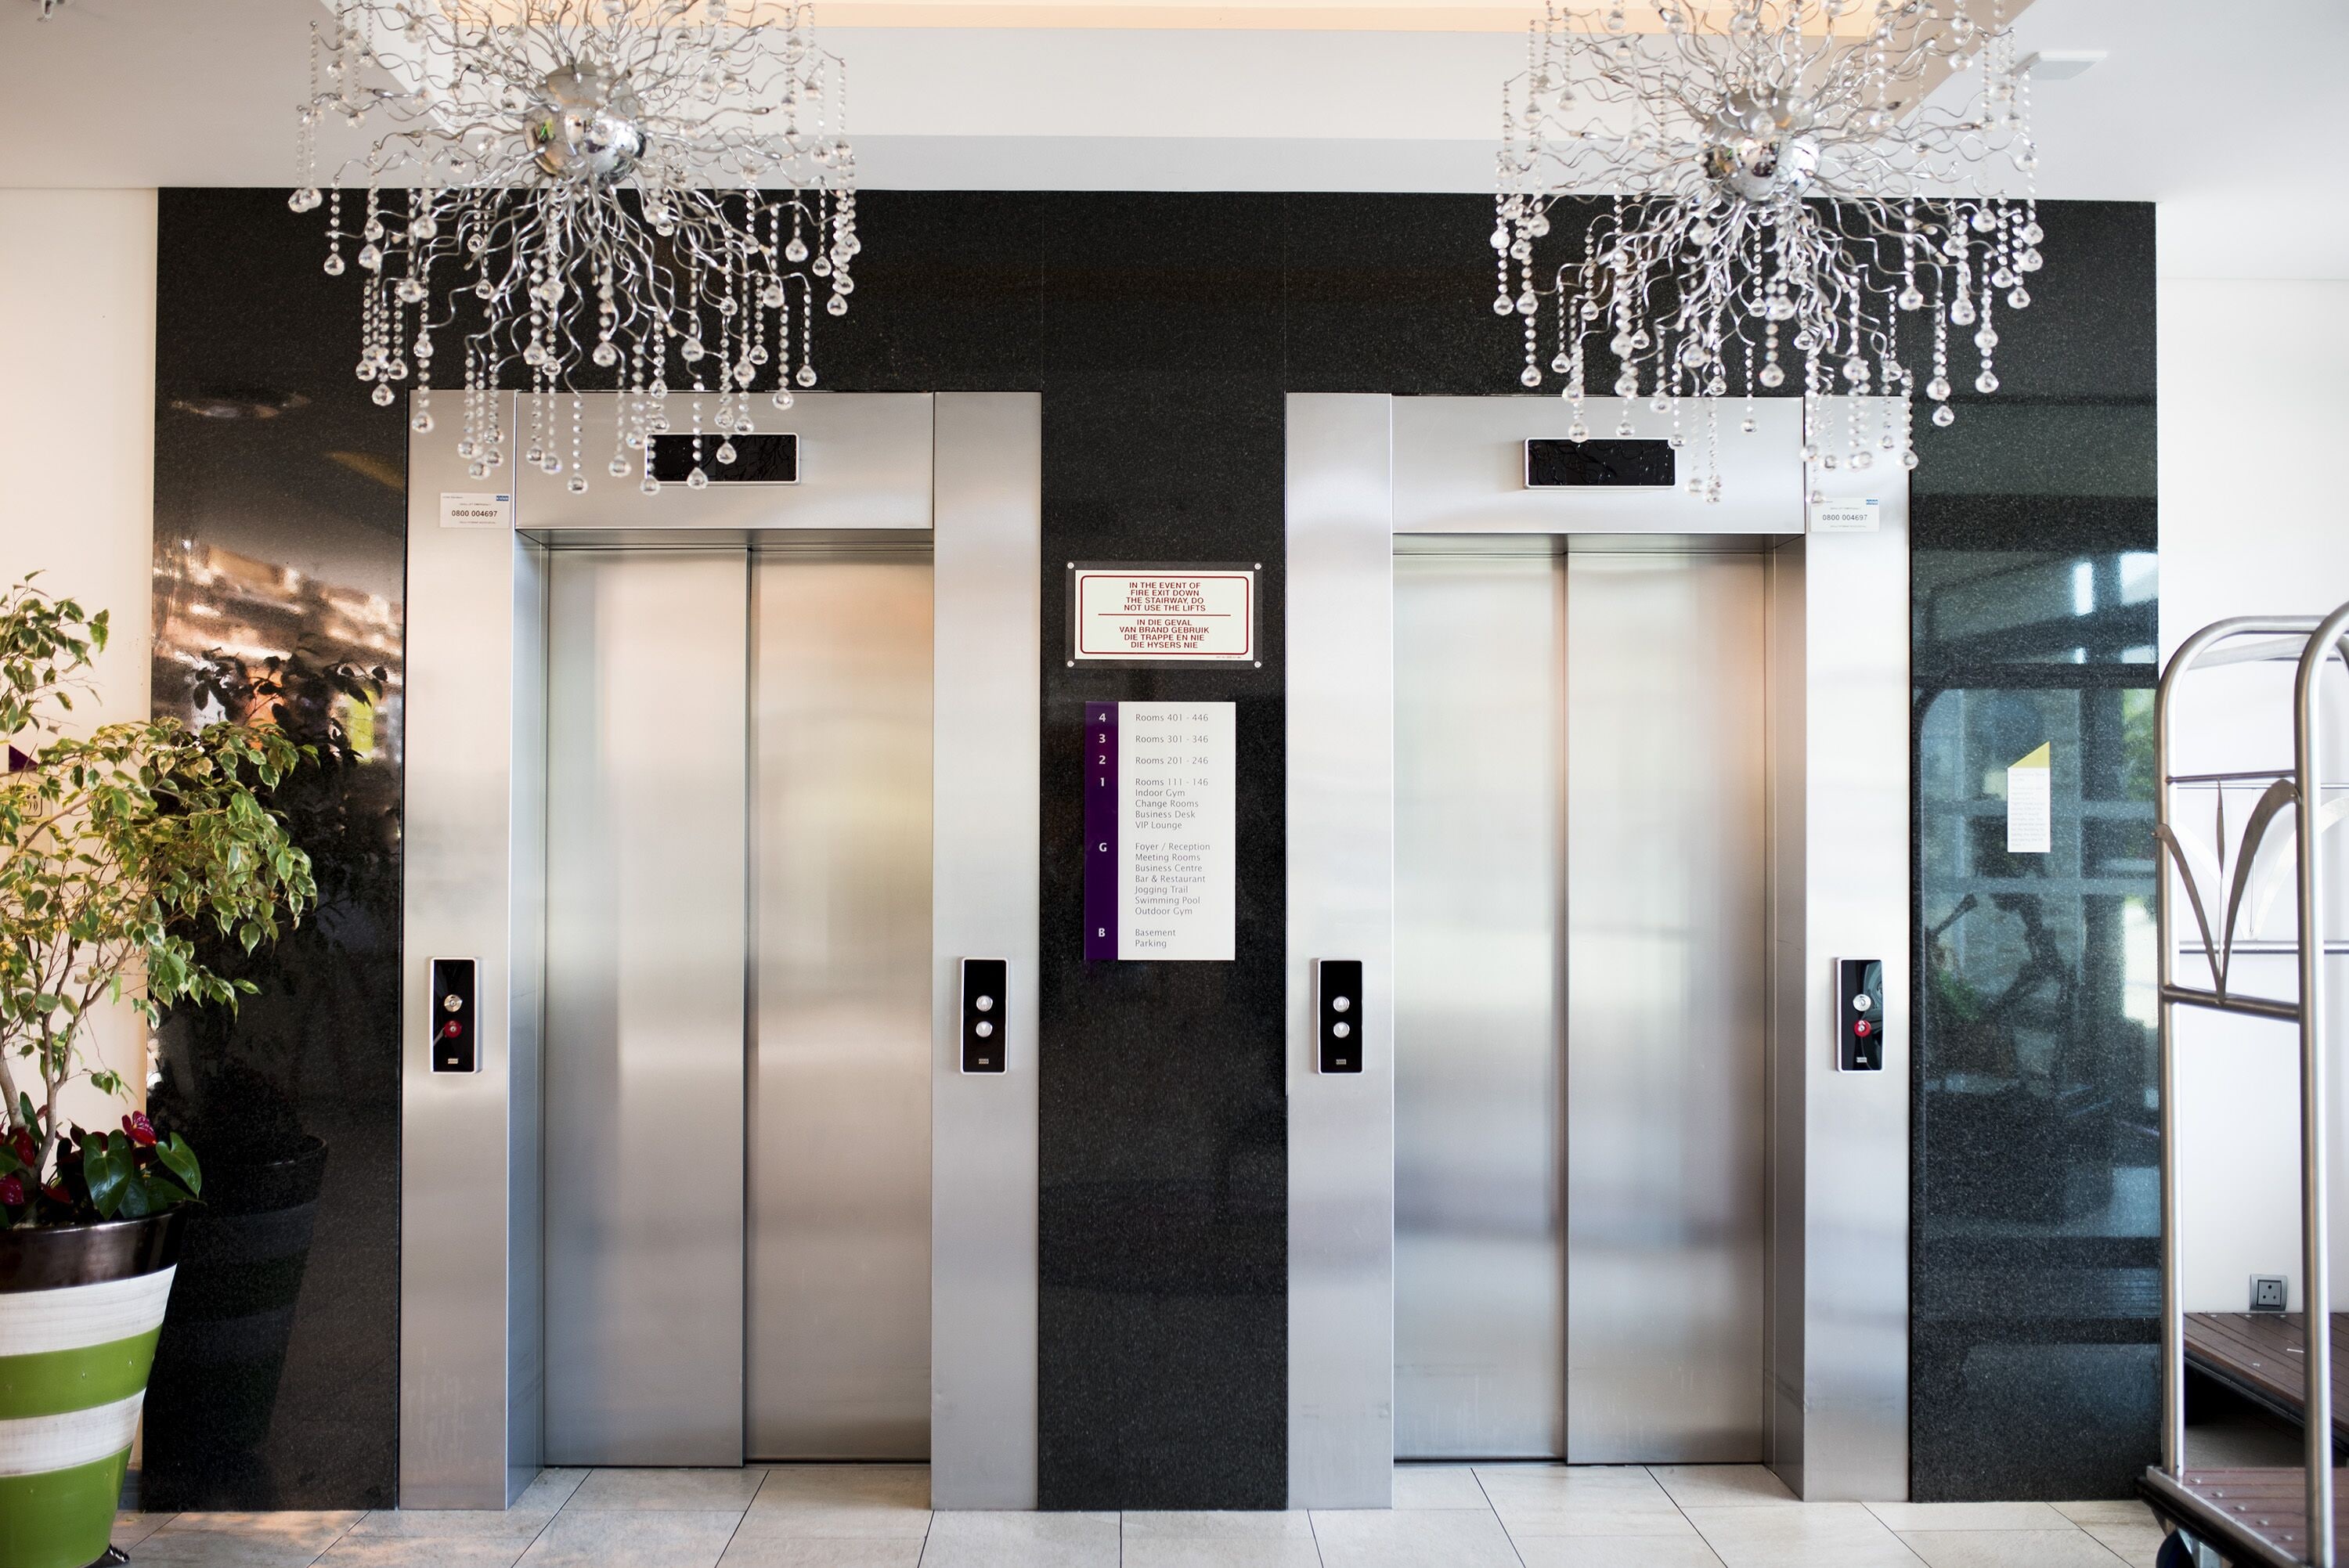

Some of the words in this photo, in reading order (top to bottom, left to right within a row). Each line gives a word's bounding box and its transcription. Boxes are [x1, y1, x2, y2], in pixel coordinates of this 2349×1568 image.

[1099, 713, 1106, 723] 4
[1099, 734, 1106, 743] 3
[1099, 755, 1106, 764] 2
[1100, 777, 1105, 787] 1
[1166, 789, 1185, 798] Gym
[1135, 800, 1167, 809] Change
[1151, 821, 1182, 830] Lounge
[1099, 843, 1107, 852] G
[1135, 853, 1169, 862] Meeting
[1135, 896, 1179, 905] Swimming
[1173, 907, 1193, 916] Gym
[1099, 928, 1106, 937] B
[1135, 939, 1167, 949] Parking
